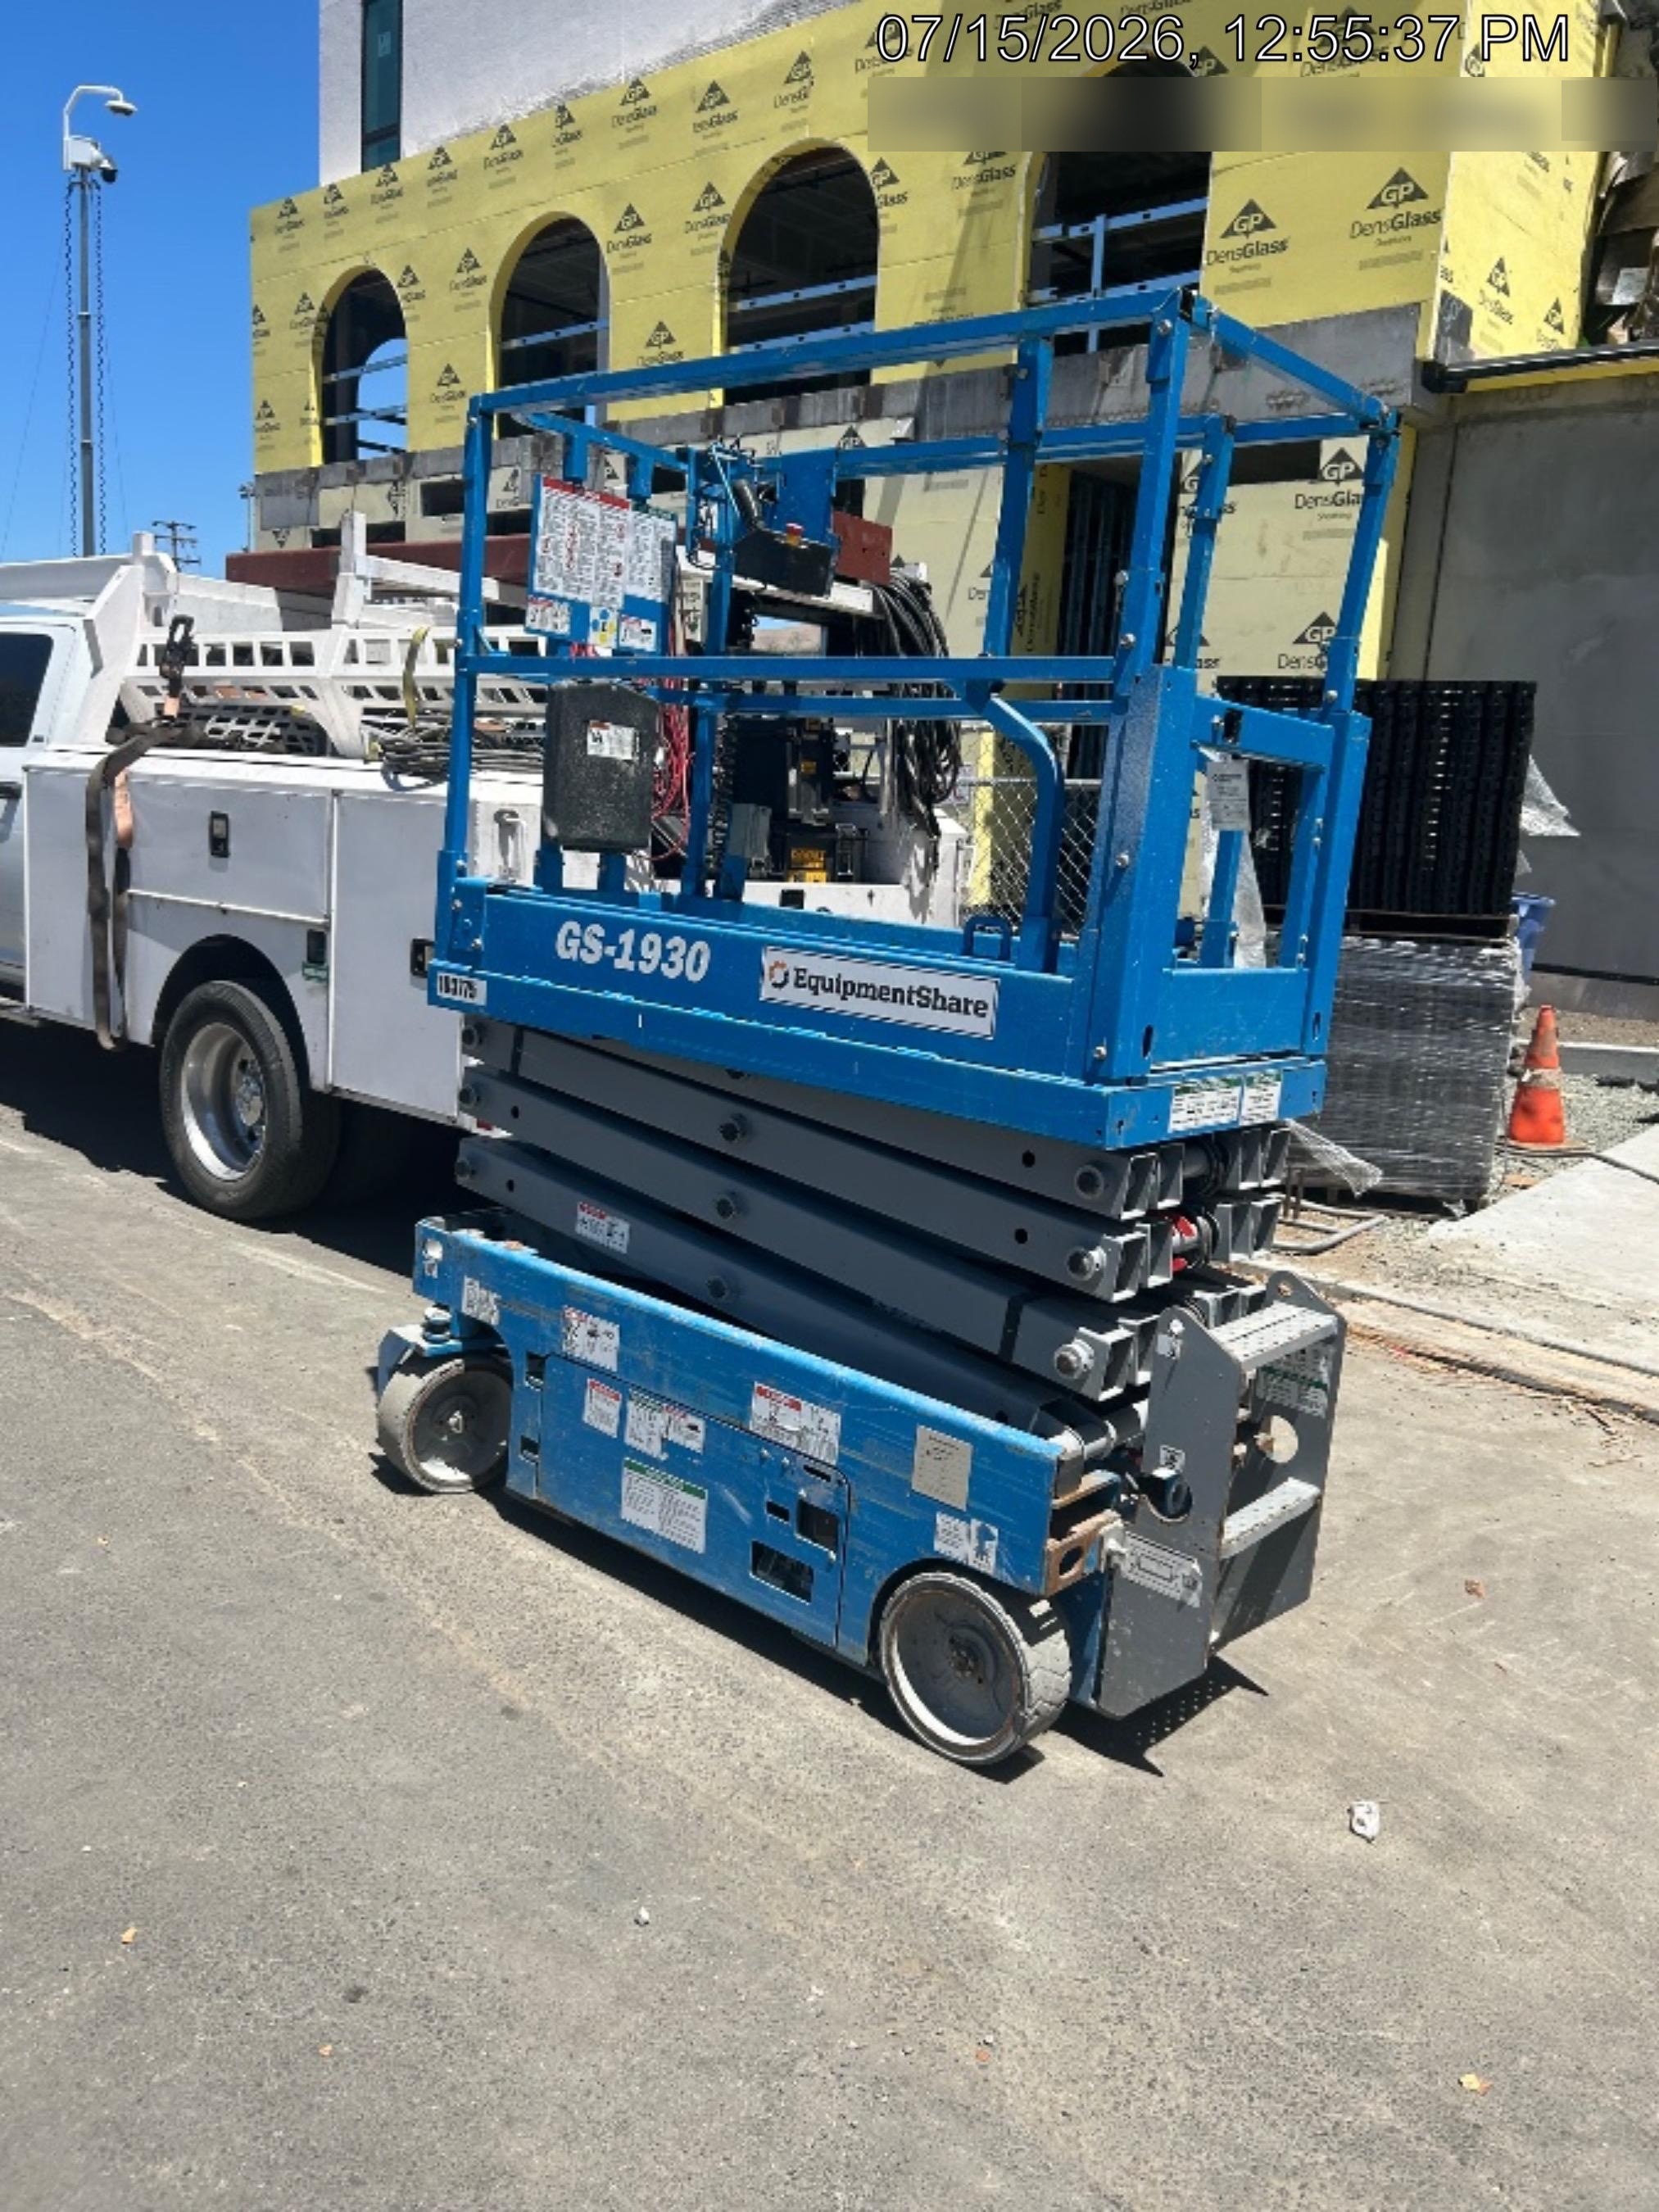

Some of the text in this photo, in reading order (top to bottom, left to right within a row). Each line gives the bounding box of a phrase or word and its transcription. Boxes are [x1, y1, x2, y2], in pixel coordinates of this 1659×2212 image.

[1380, 182, 1415, 205] GP
[1233, 213, 1264, 233] GP
[1349, 208, 1442, 240] DensGlass
[1205, 237, 1289, 266] DensGlass
[1322, 464, 1357, 482] GP
[555, 920, 711, 983] GS-1930
[793, 968, 989, 1018] EquipmentShare
